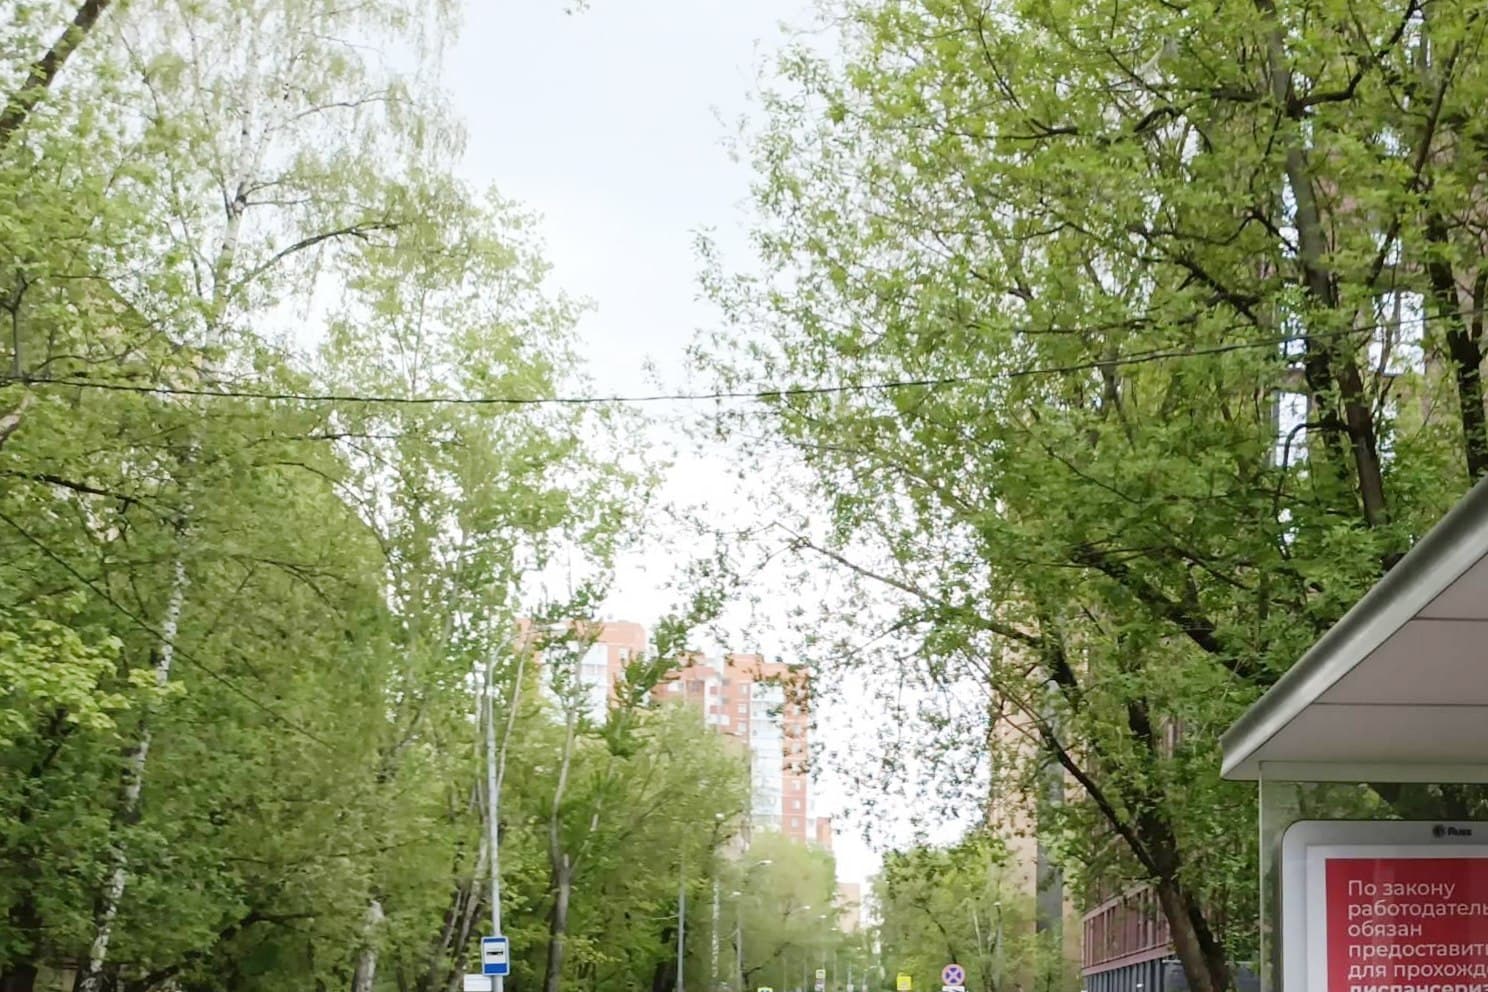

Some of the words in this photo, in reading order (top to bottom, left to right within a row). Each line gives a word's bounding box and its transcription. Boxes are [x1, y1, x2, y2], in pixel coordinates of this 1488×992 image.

[1348, 880, 1377, 896] По
[1382, 882, 1455, 899] закону
[1348, 920, 1422, 937] обязан
[1348, 963, 1387, 980] для
